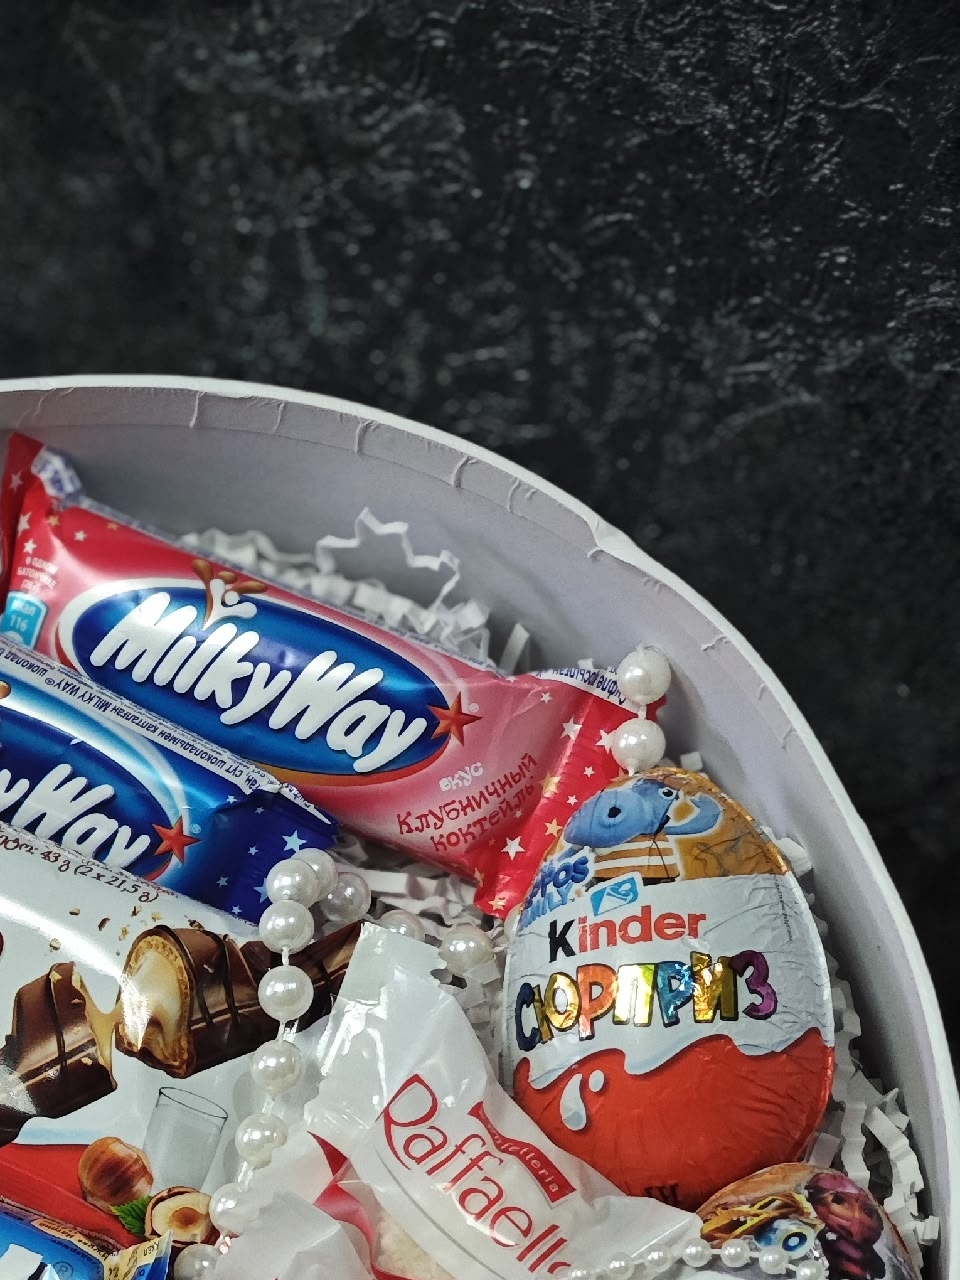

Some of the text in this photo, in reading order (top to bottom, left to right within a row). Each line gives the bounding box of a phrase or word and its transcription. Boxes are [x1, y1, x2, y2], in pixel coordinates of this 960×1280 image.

[10, 615, 29, 632] 116
[76, 687, 112, 714] MILKY
[41, 849, 61, 865] 43
[105, 874, 142, 894] 21,5
[548, 905, 707, 963] Kinder
[514, 949, 778, 1052] СЮРПРИЗ
